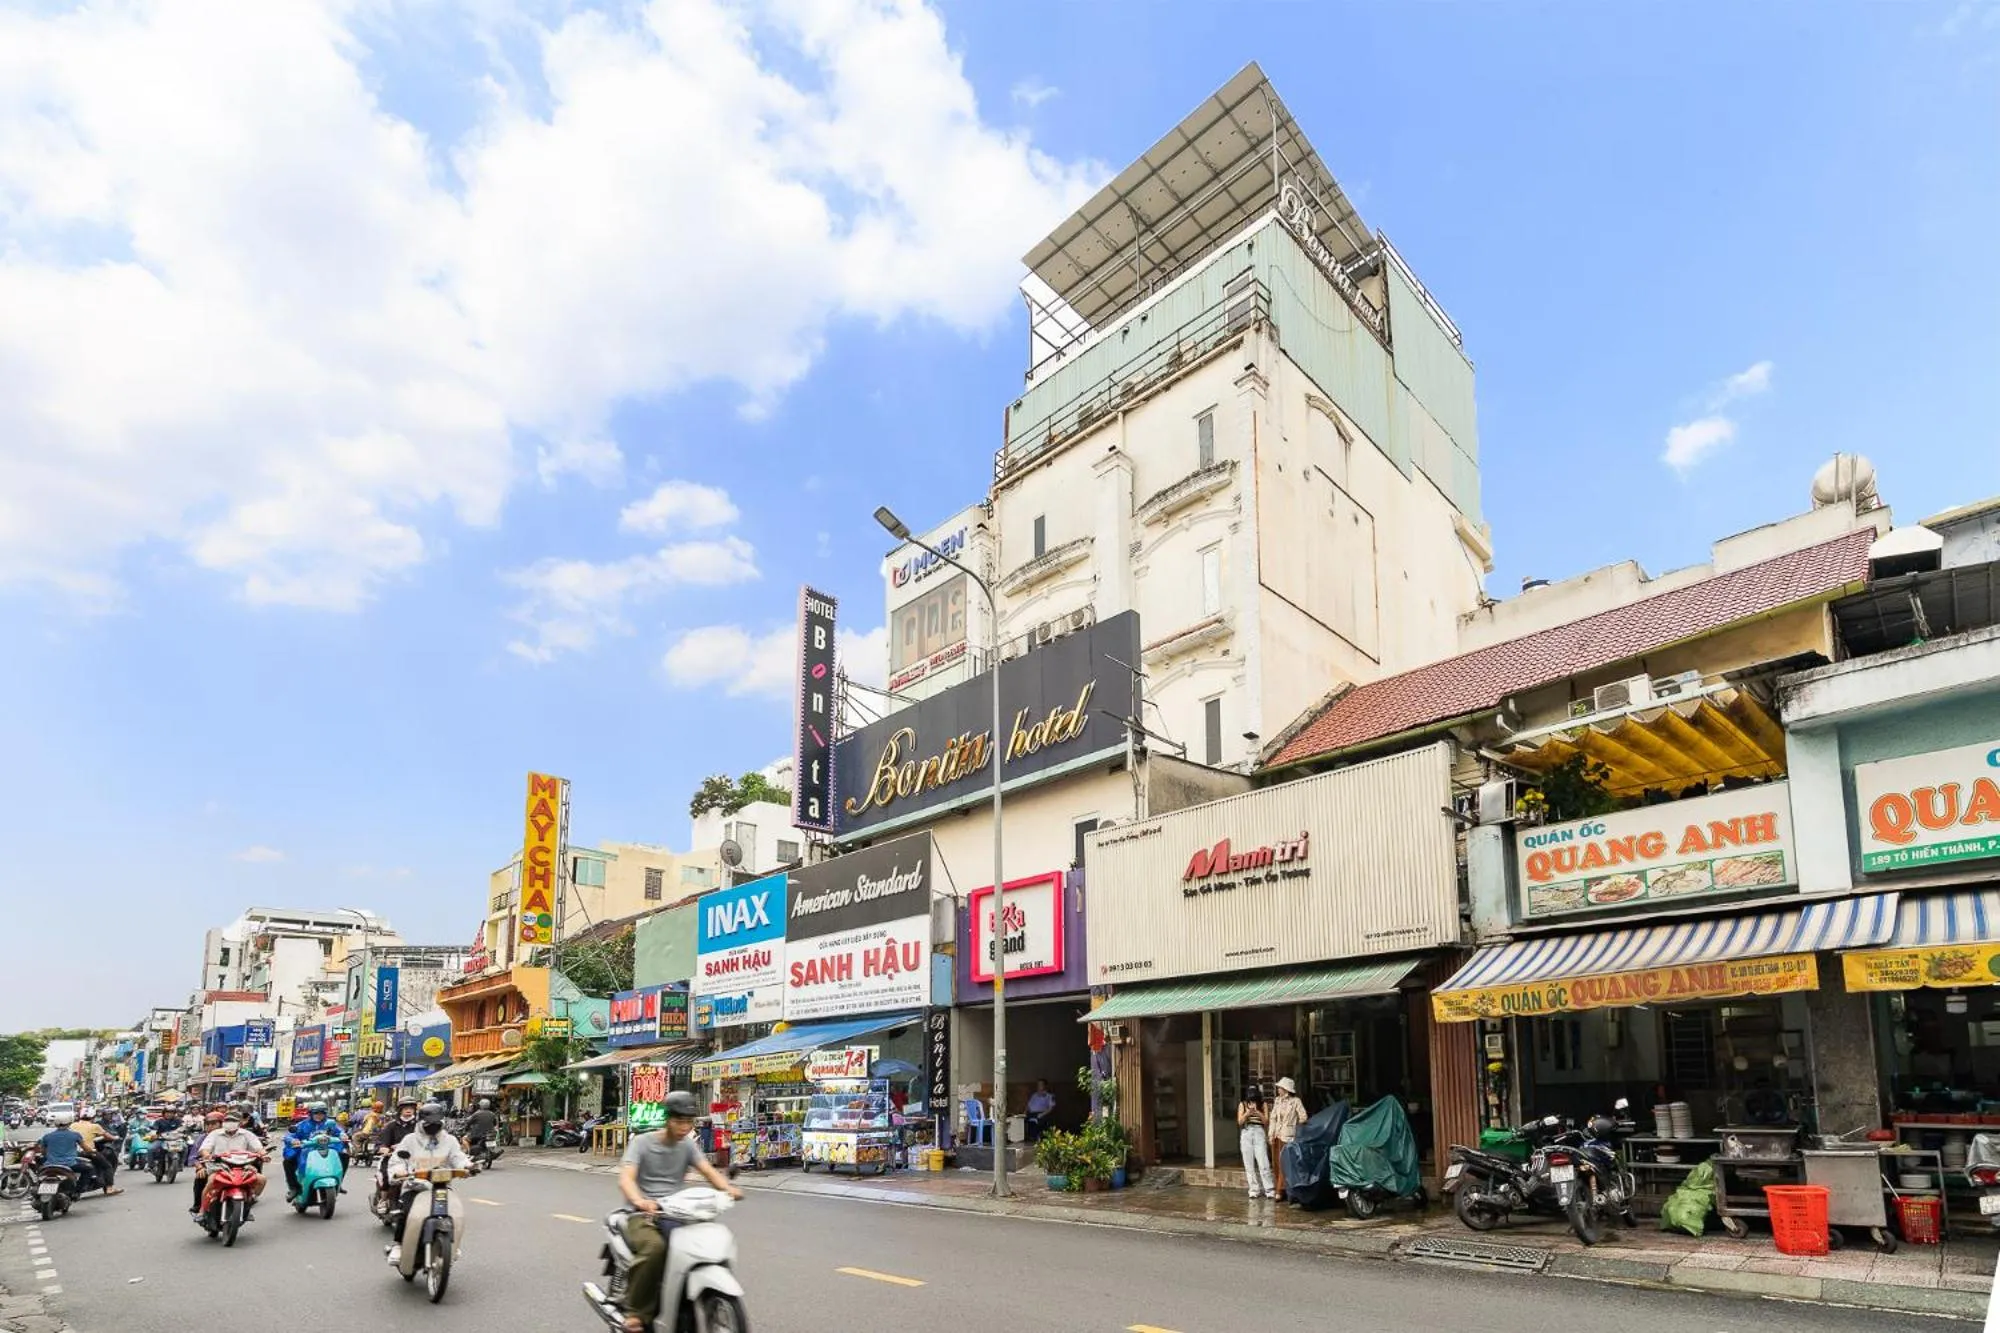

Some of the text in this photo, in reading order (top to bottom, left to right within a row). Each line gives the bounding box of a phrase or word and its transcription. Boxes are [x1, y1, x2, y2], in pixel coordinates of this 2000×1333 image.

[807, 597, 836, 621] HOTEL
[808, 624, 827, 819] Bonita
[844, 678, 1097, 817] Bonita hotel
[1523, 820, 1607, 849] QUÁN ỐC
[1525, 811, 1779, 882] QUANG ANH
[1872, 855, 1891, 866] 189
[791, 860, 923, 919] American Standard
[706, 890, 771, 940] INAX
[705, 956, 740, 977] SANH
[742, 949, 771, 971] HẬU
[790, 952, 853, 988] SANH
[864, 937, 921, 980] HẬU
[989, 930, 1025, 961] gand
[1501, 986, 1542, 1013] QUÁN
[1571, 972, 1662, 1007] QUANG
[1667, 964, 1729, 994] ANH
[930, 1014, 946, 1094] Bonita
